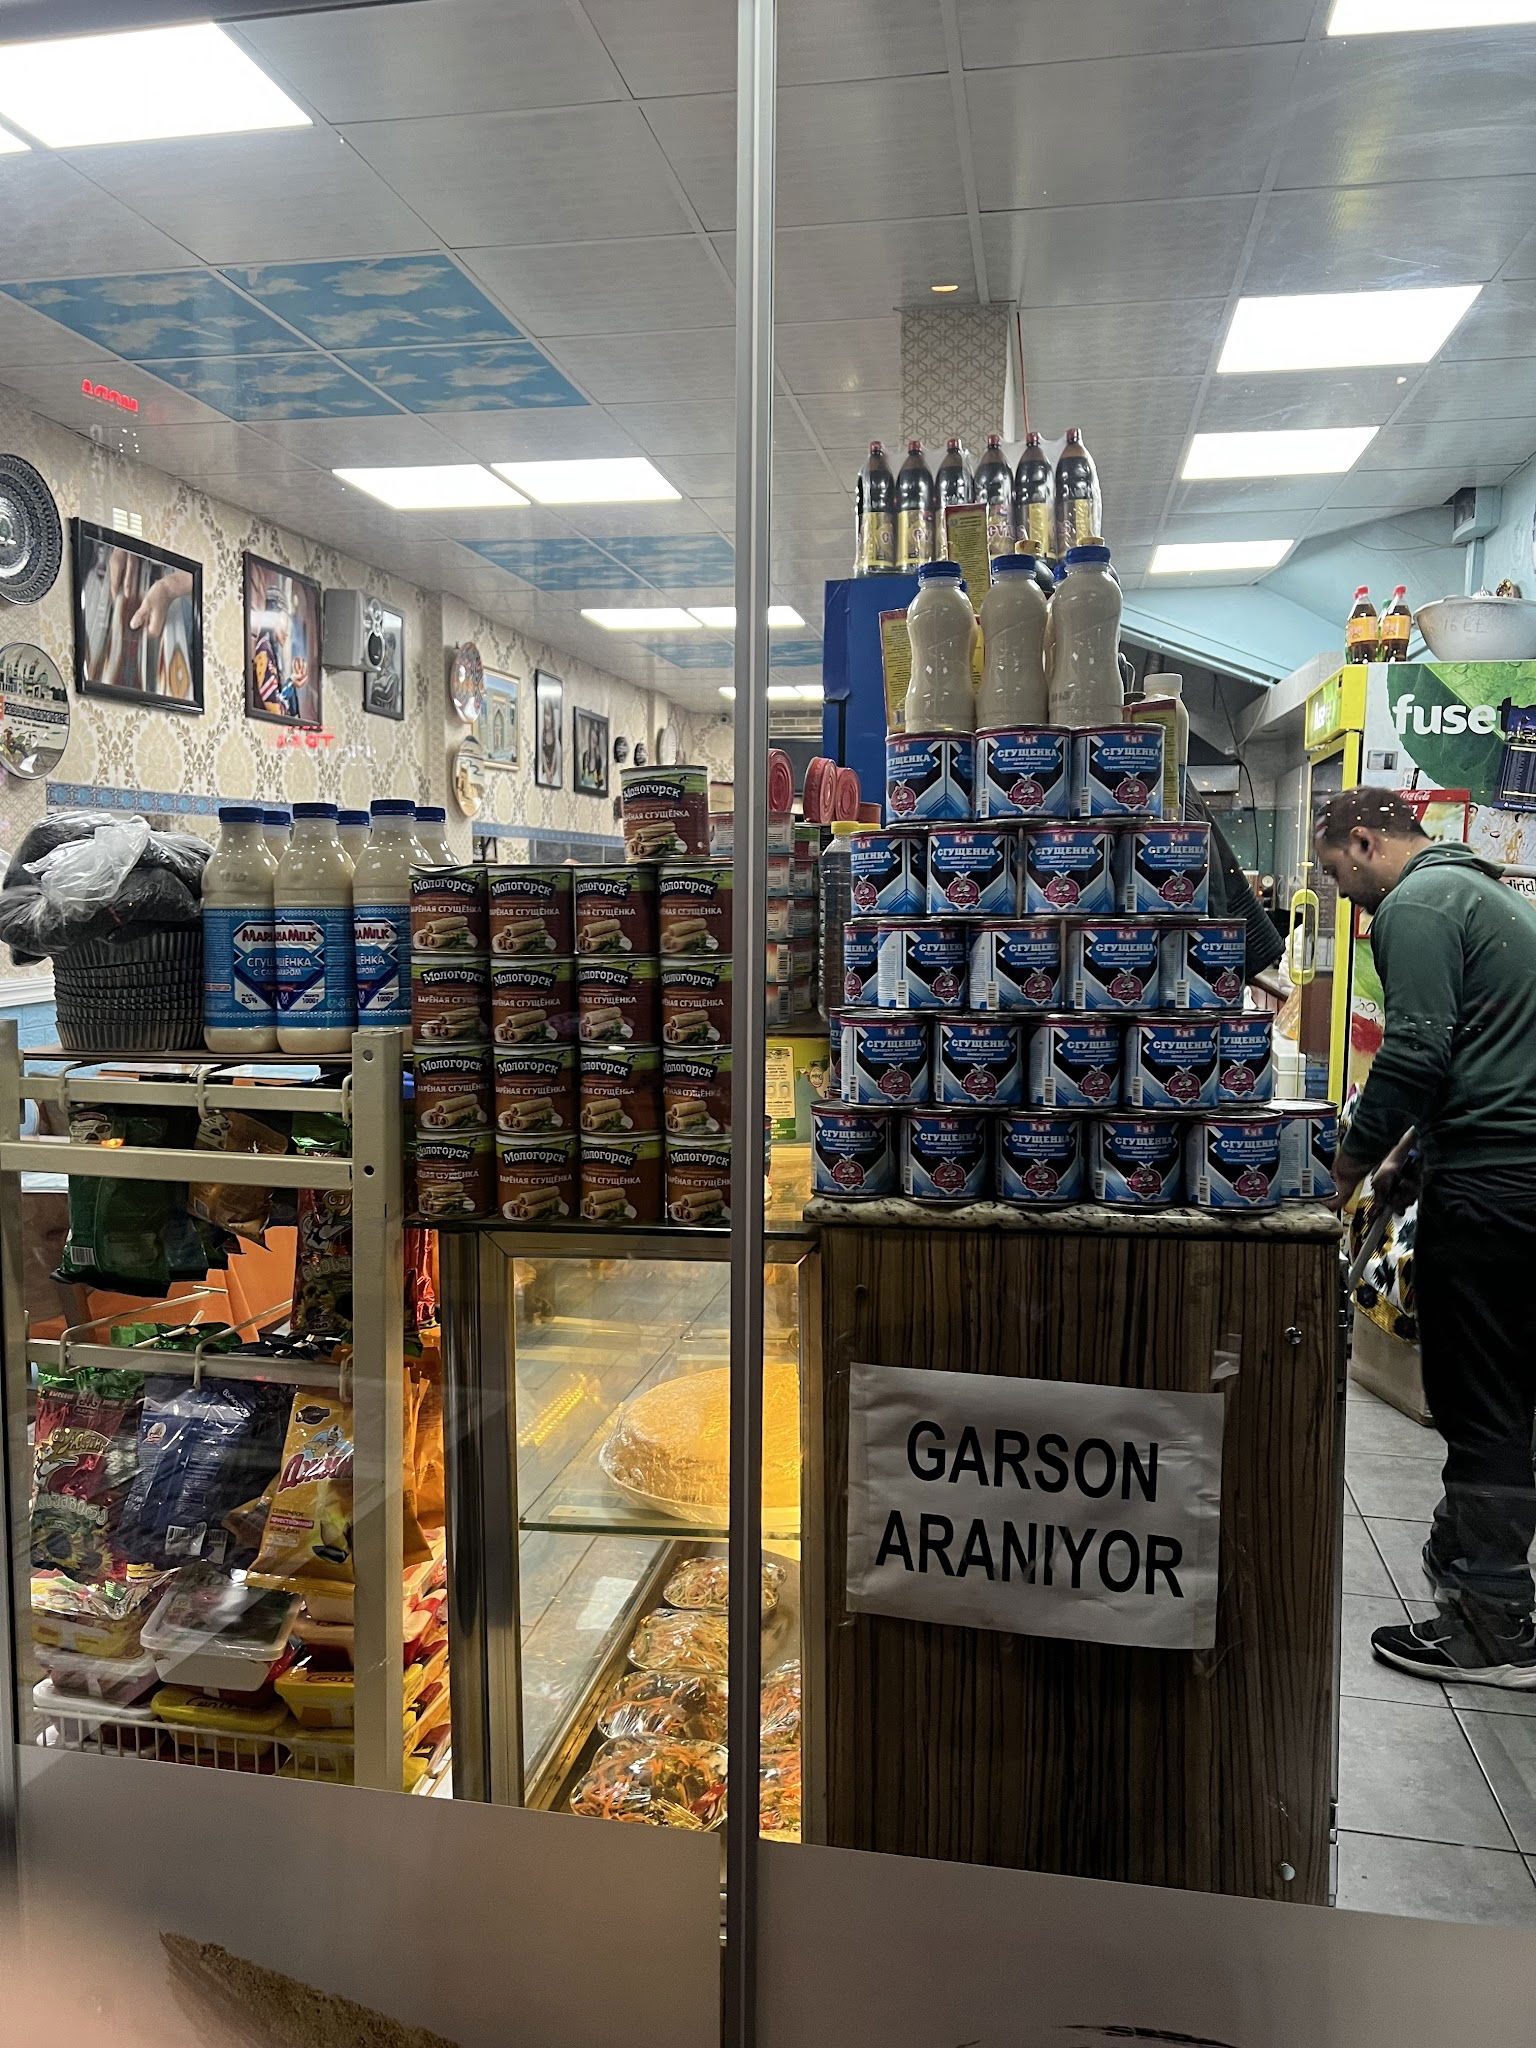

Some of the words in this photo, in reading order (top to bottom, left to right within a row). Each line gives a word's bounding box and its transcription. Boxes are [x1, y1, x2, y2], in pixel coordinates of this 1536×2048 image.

[997, 747, 1057, 758] СГУЩЕНКА
[1102, 747, 1160, 757] СГУЩЕНКА
[937, 847, 995, 857] СГУЩЕНКА
[1035, 846, 1096, 856] СГУЩЕНКА
[413, 878, 476, 894] Мологорск
[491, 880, 552, 896] Мологорск
[494, 973, 553, 987] Мологорск
[866, 1039, 922, 1048] СГУЩЕНКА
[951, 1039, 1010, 1048] СГУЩЕНКА
[1152, 1040, 1214, 1050] СГУЩЕНКА
[420, 1058, 482, 1073] Мологорск
[498, 1061, 559, 1075] Мологорск
[822, 1129, 878, 1139] СГУЩЕНКА
[1011, 1134, 1070, 1144] СГУЩЕНКА
[1221, 1140, 1279, 1149] СГУЩЕНКА
[504, 1151, 565, 1164] Мологорск
[670, 1152, 730, 1167] Мологорск
[907, 1420, 1158, 1502] GARSON
[875, 1510, 1184, 1598] ARANIYOR
